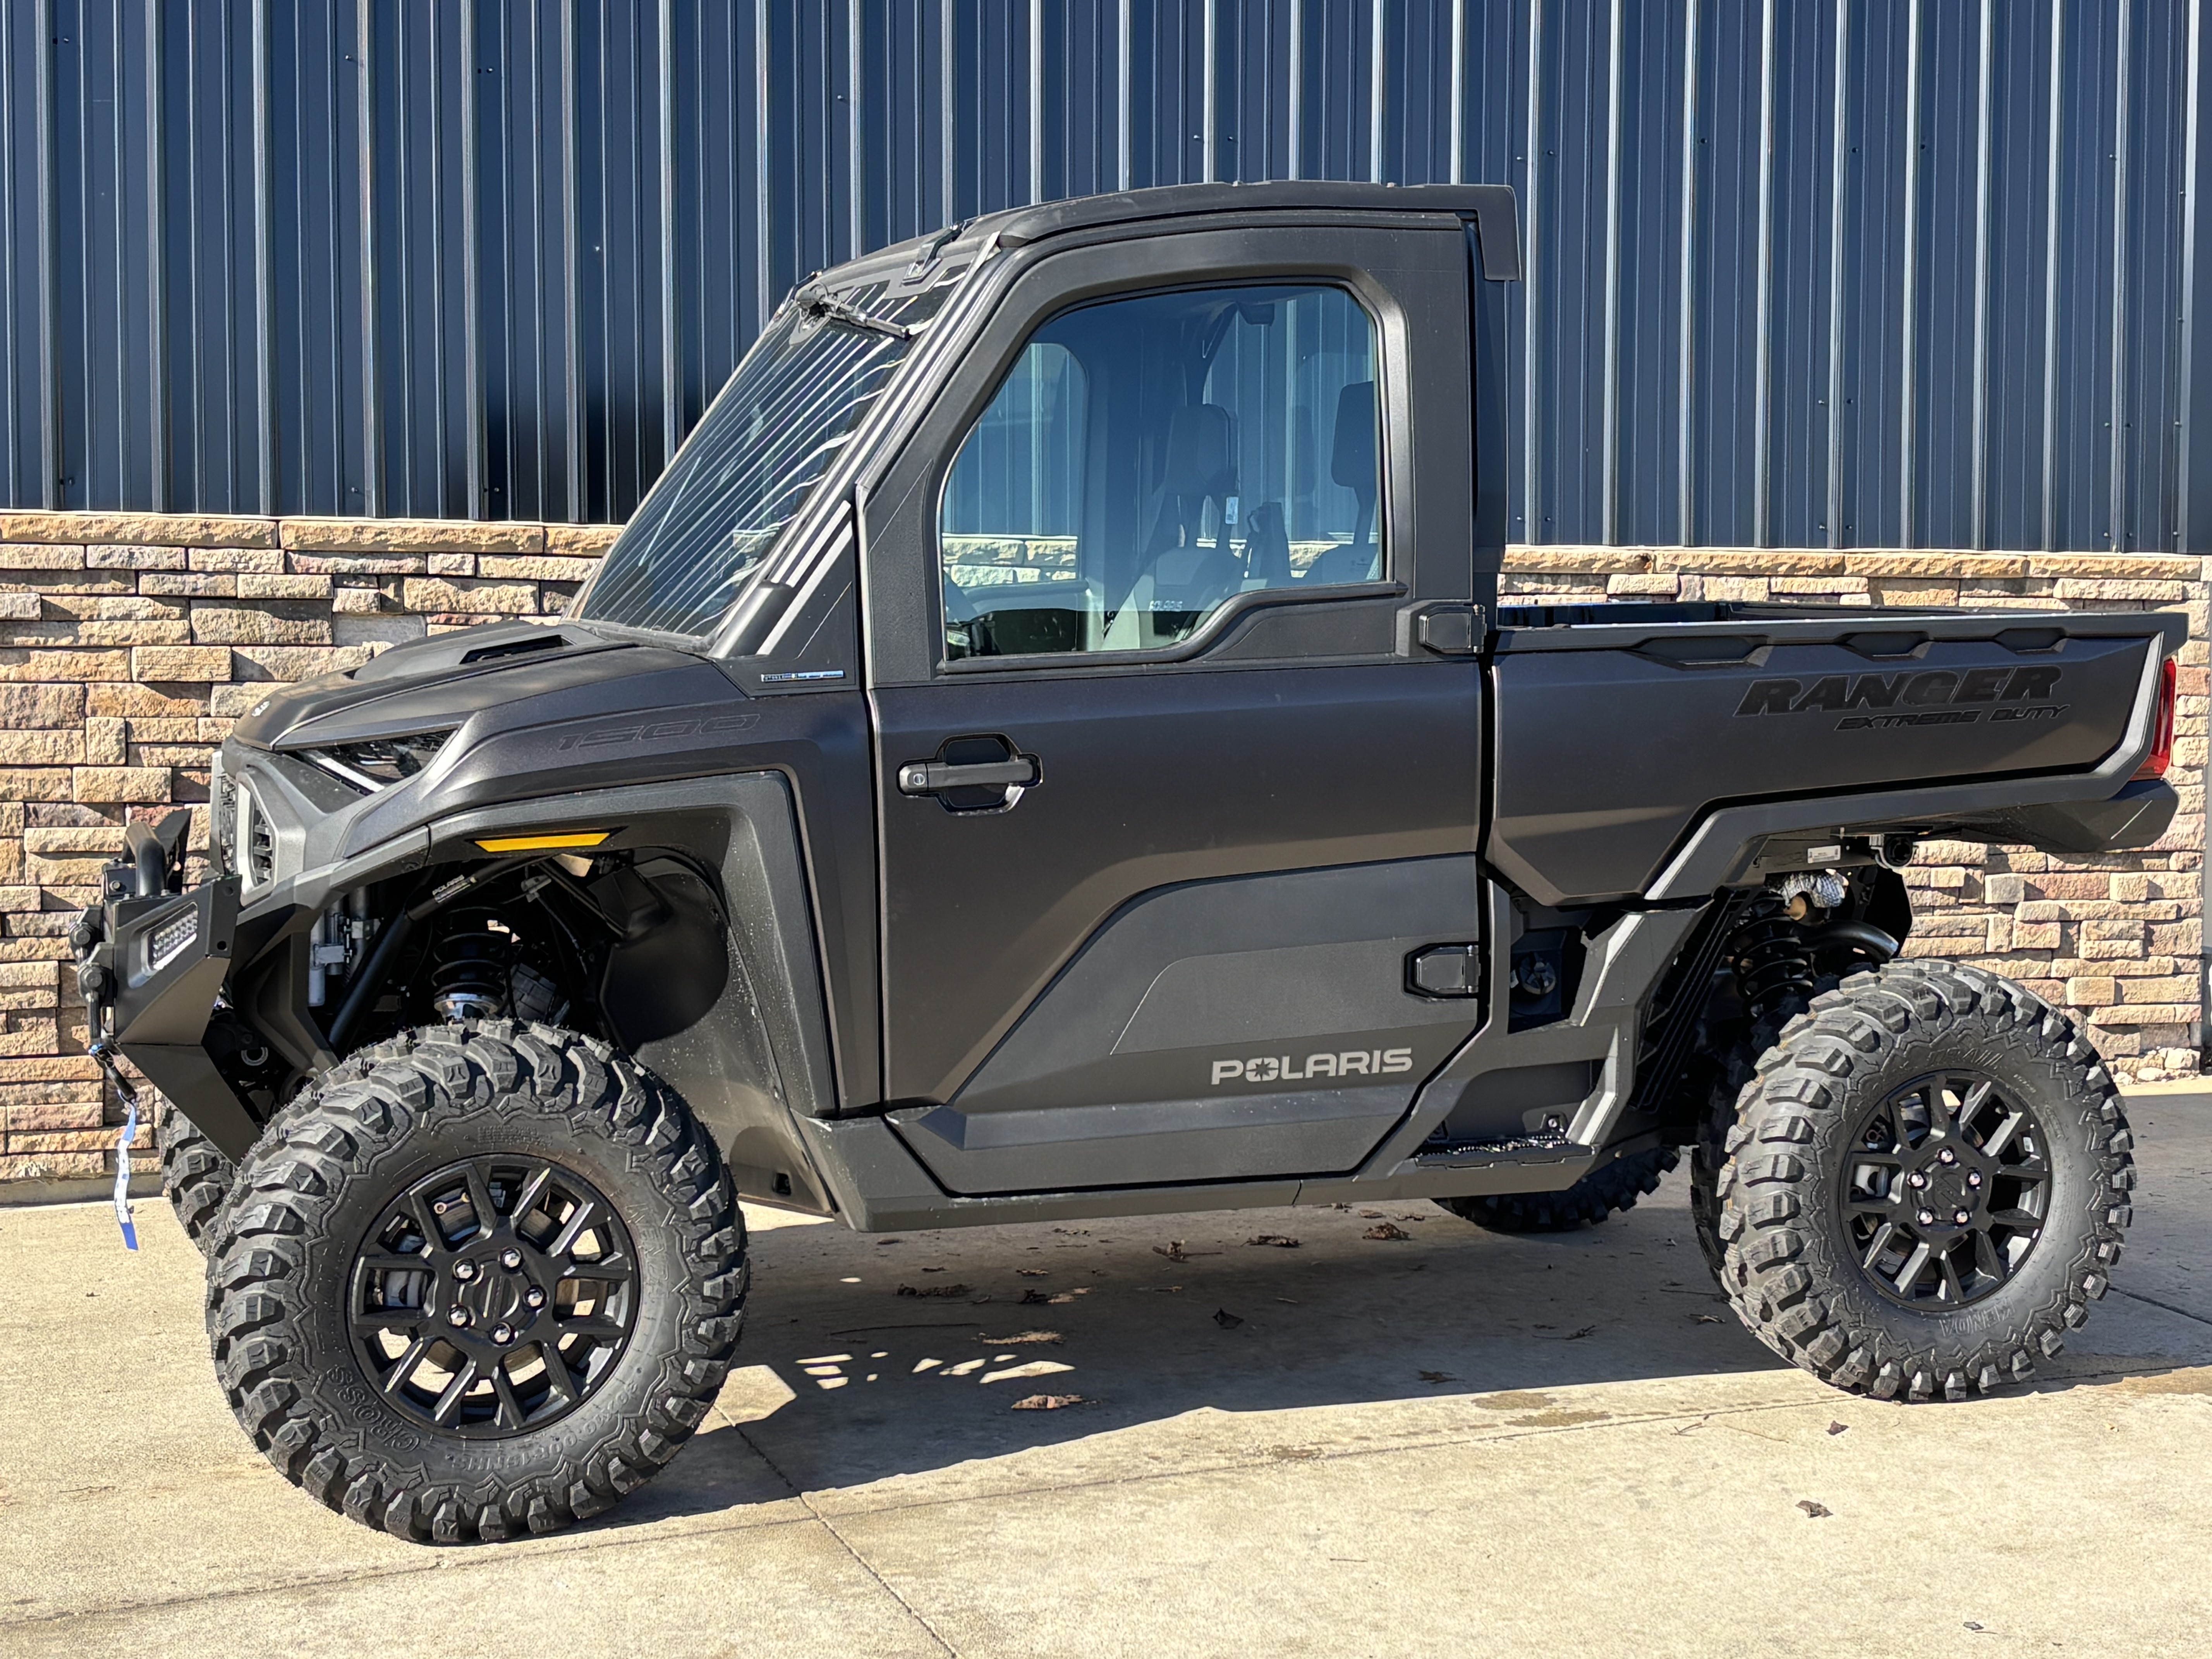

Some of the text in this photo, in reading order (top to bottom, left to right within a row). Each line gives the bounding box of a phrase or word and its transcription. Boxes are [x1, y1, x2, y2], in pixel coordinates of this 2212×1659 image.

[1733, 665, 2063, 717] RANGER
[1834, 704, 2070, 731] EXTREME DUTY
[1211, 1048, 1413, 1085] POLARIS
[326, 1365, 419, 1452] CROSS
